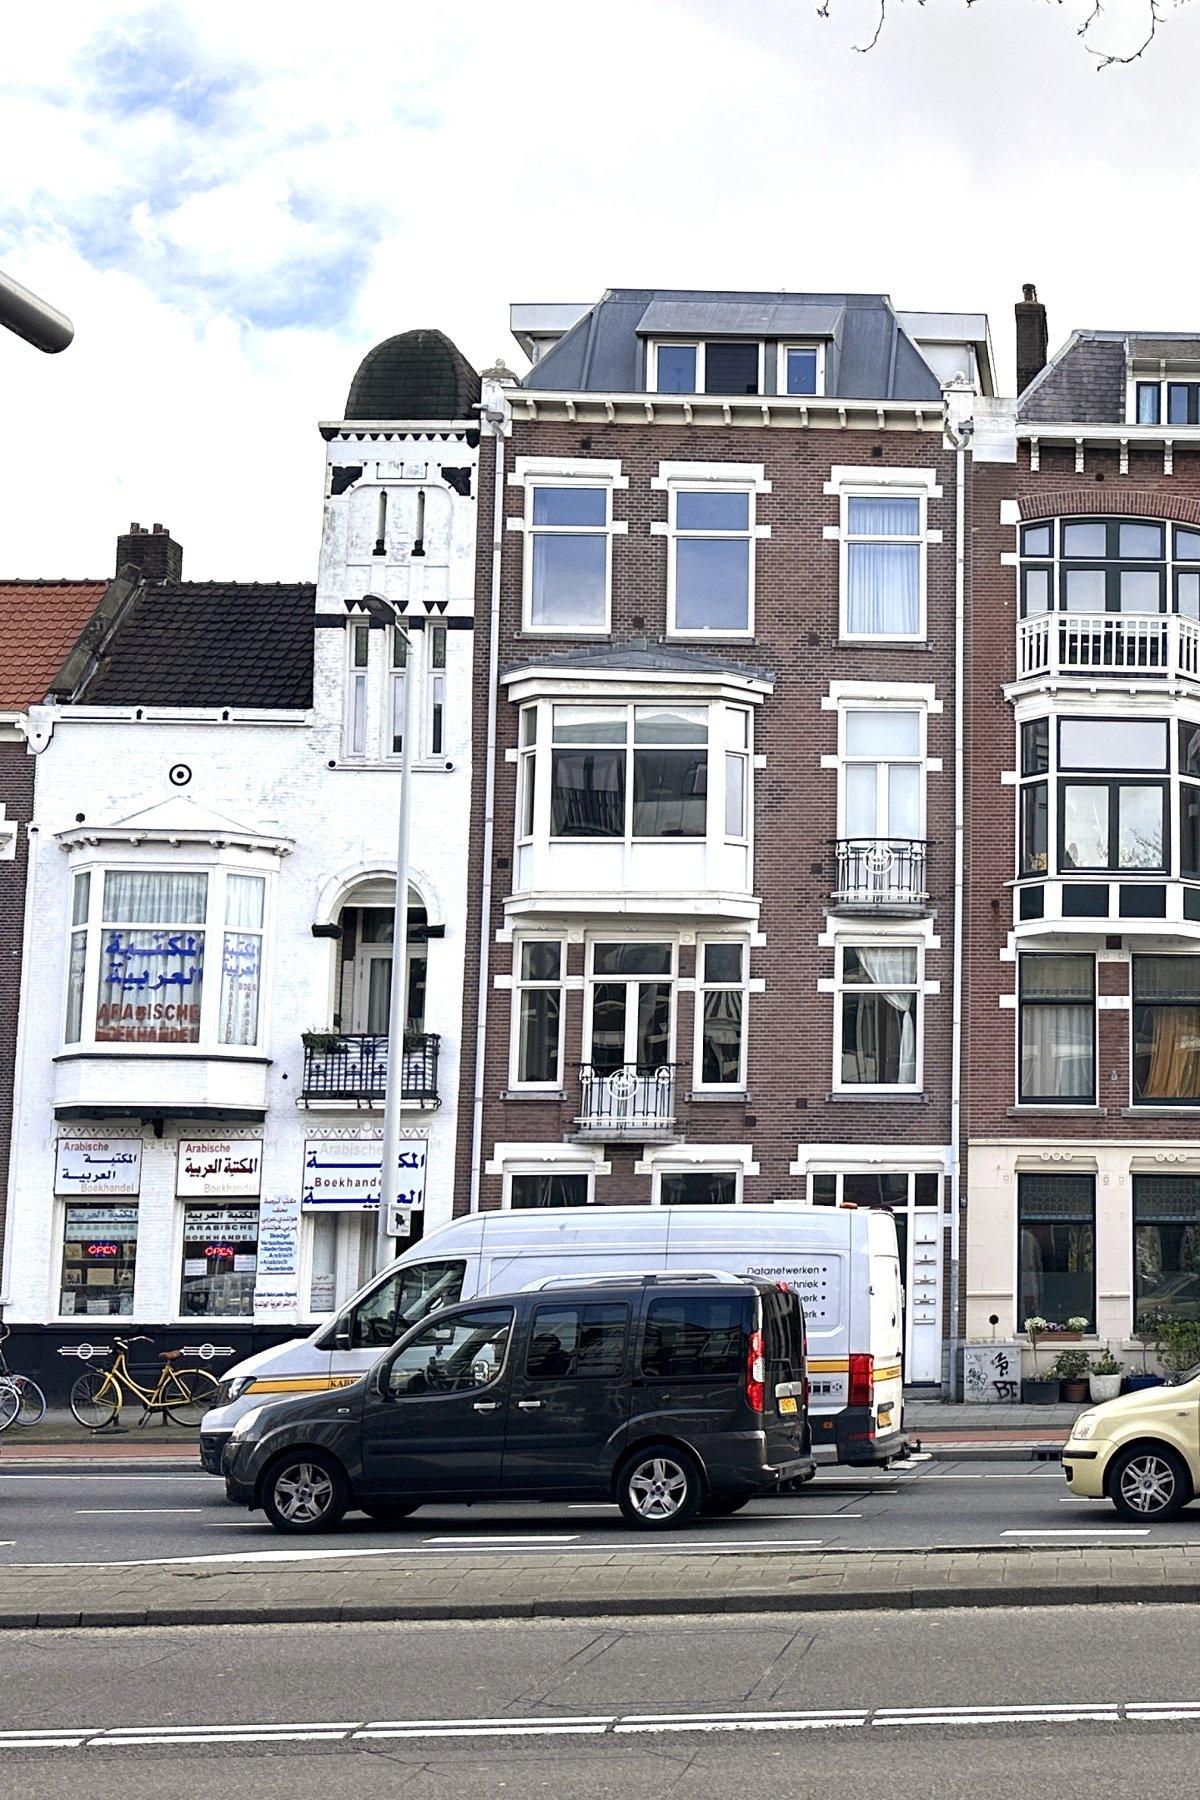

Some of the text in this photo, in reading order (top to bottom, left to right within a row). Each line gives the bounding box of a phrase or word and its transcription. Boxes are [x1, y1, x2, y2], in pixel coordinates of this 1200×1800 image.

[97, 1003, 201, 1022] ARABISCHE
[63, 1141, 109, 1151] Arabische
[185, 1143, 231, 1153] Arabische
[83, 1152, 137, 1166] المكتبة
[185, 1157, 258, 1178] المكتبة العربية
[62, 1168, 116, 1182] العربية
[314, 1177, 381, 1188] Boekhand
[88, 1244, 118, 1255] OPEN
[205, 1246, 234, 1256] OPEN
[747, 1266, 820, 1275] Datanetwerken
